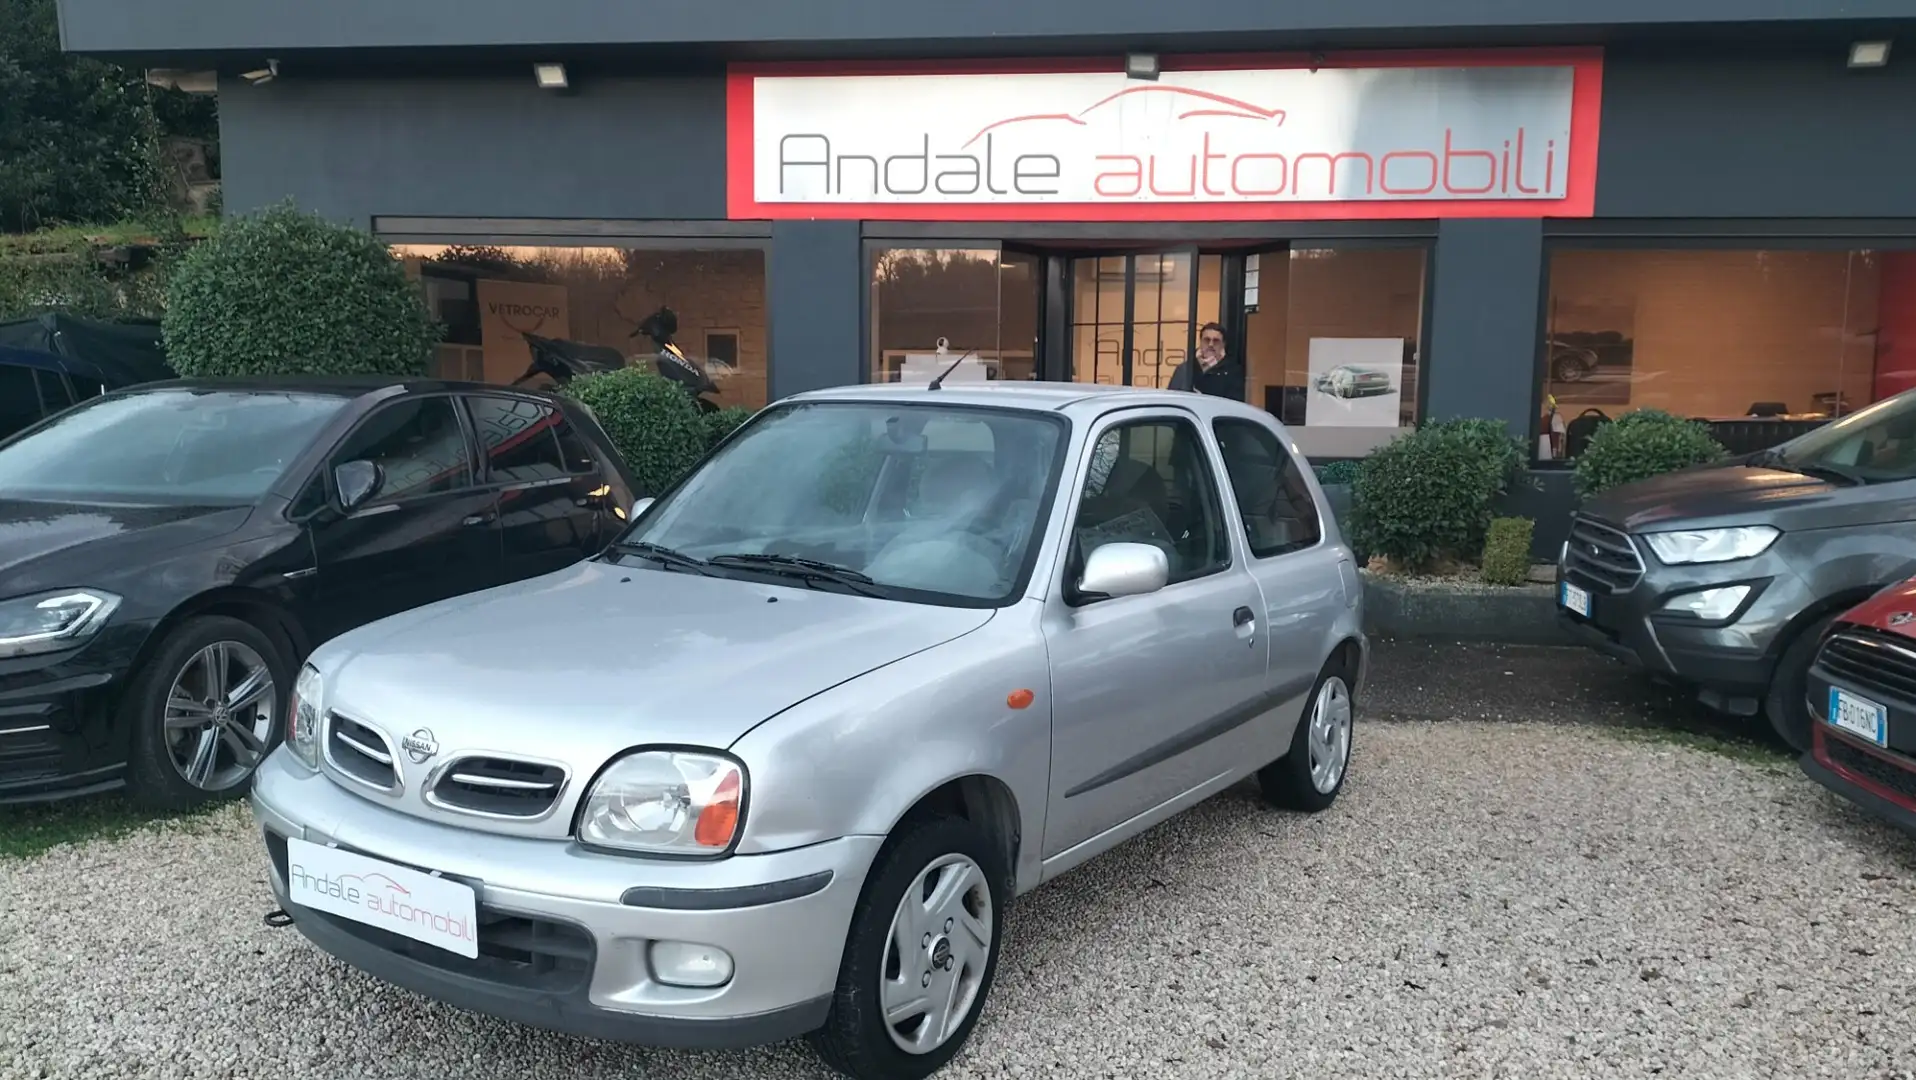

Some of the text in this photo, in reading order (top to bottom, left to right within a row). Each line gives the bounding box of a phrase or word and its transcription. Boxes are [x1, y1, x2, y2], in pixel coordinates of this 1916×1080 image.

[780, 127, 1555, 197] Andale automobili
[488, 301, 560, 319] VETROCAR
[661, 348, 700, 377] HONDA
[402, 735, 432, 752] NISSAN
[291, 863, 475, 942] Andale automobili
